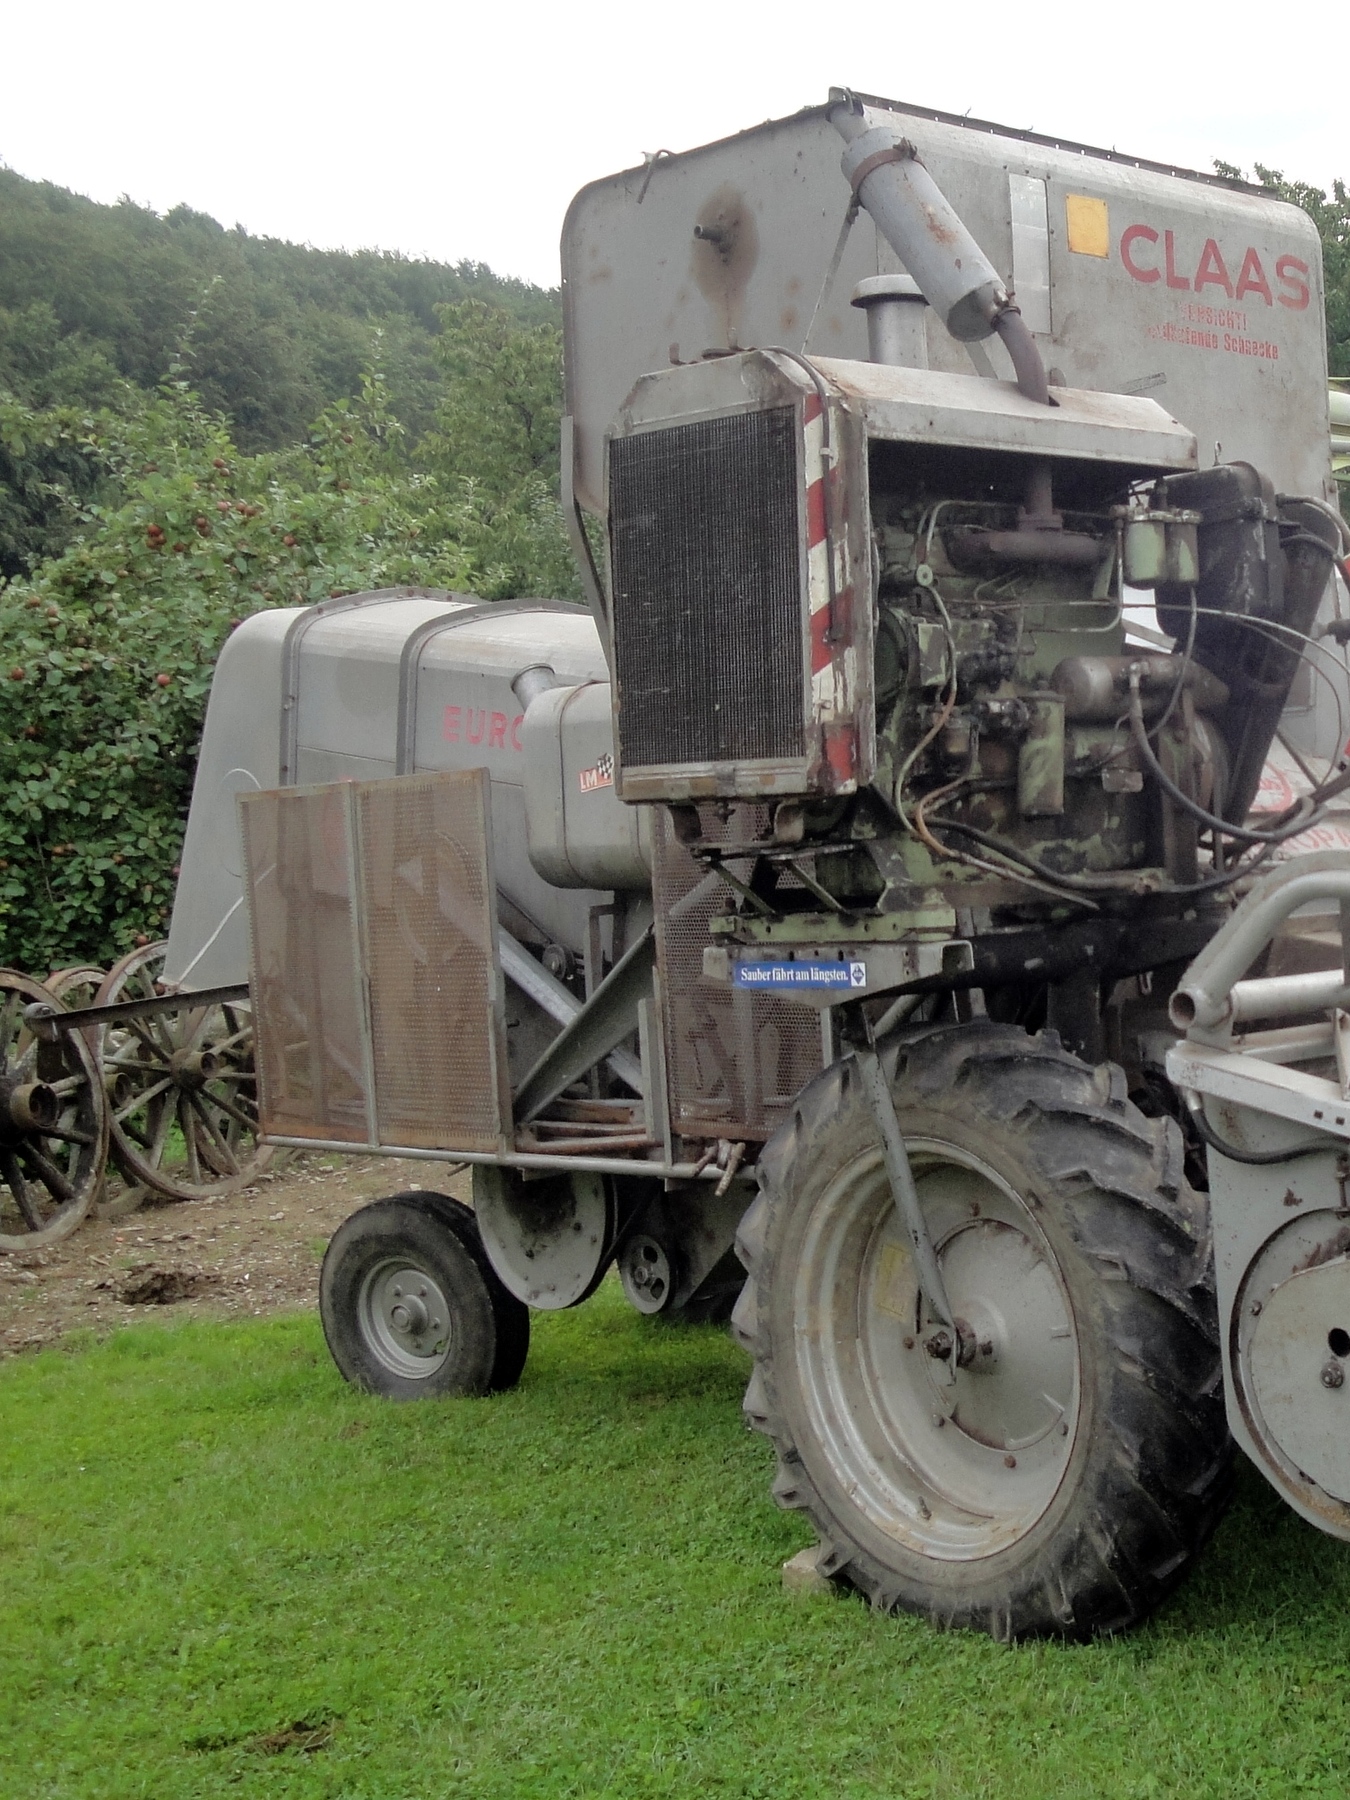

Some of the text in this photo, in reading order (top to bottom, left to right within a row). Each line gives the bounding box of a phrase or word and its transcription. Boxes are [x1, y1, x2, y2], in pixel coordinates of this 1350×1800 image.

[1120, 223, 1310, 312] CLAAS
[741, 967, 849, 984] Sauber fährt am längsten.
